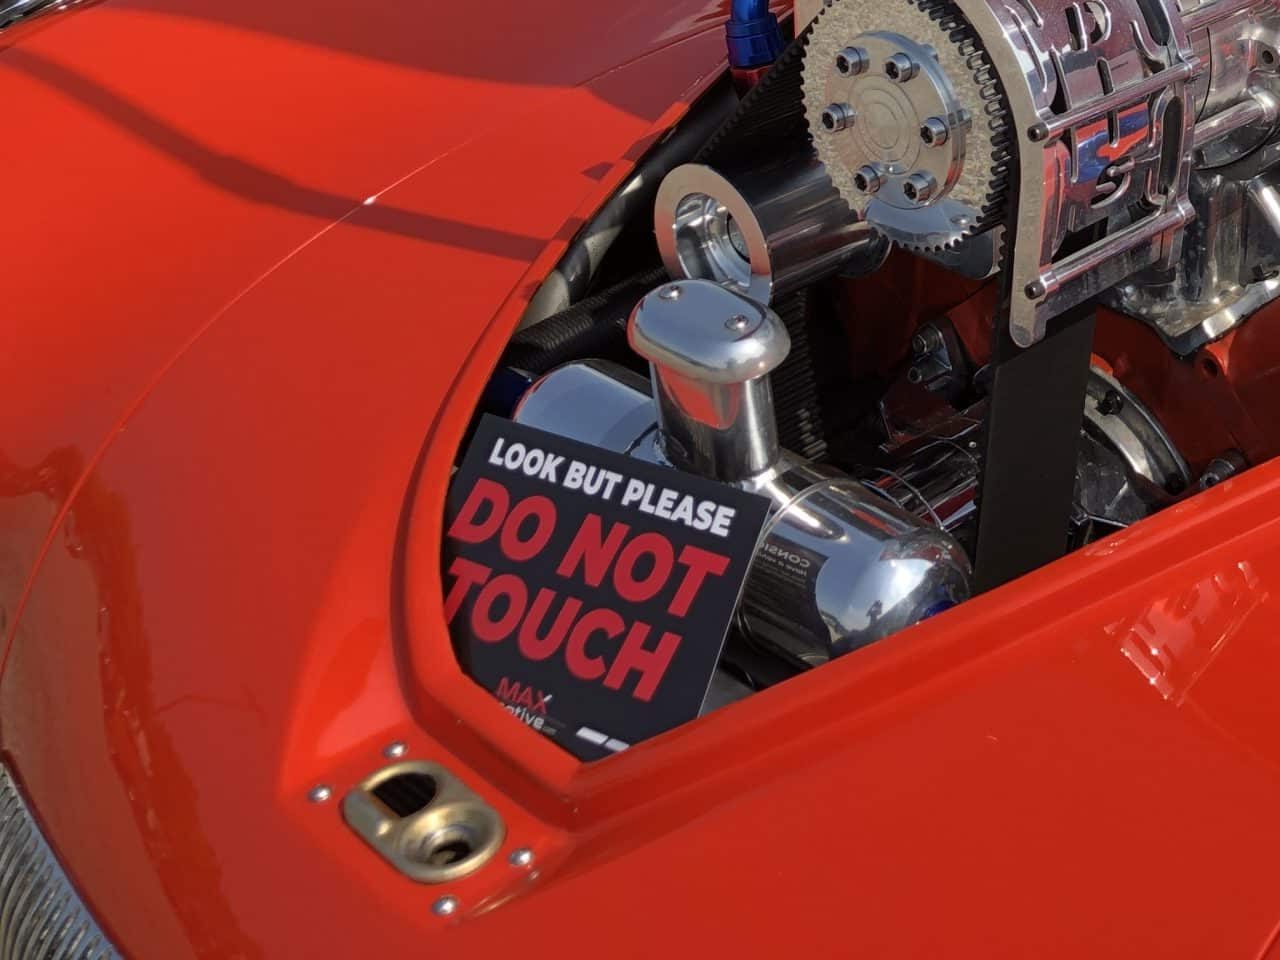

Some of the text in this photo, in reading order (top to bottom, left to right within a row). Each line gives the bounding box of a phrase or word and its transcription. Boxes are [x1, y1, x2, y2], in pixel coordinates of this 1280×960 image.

[447, 477, 732, 618] DO NOT
[488, 438, 736, 538] LOOK BUT PLEASE
[444, 557, 682, 704] TOUCH
[497, 677, 552, 716] MAX
